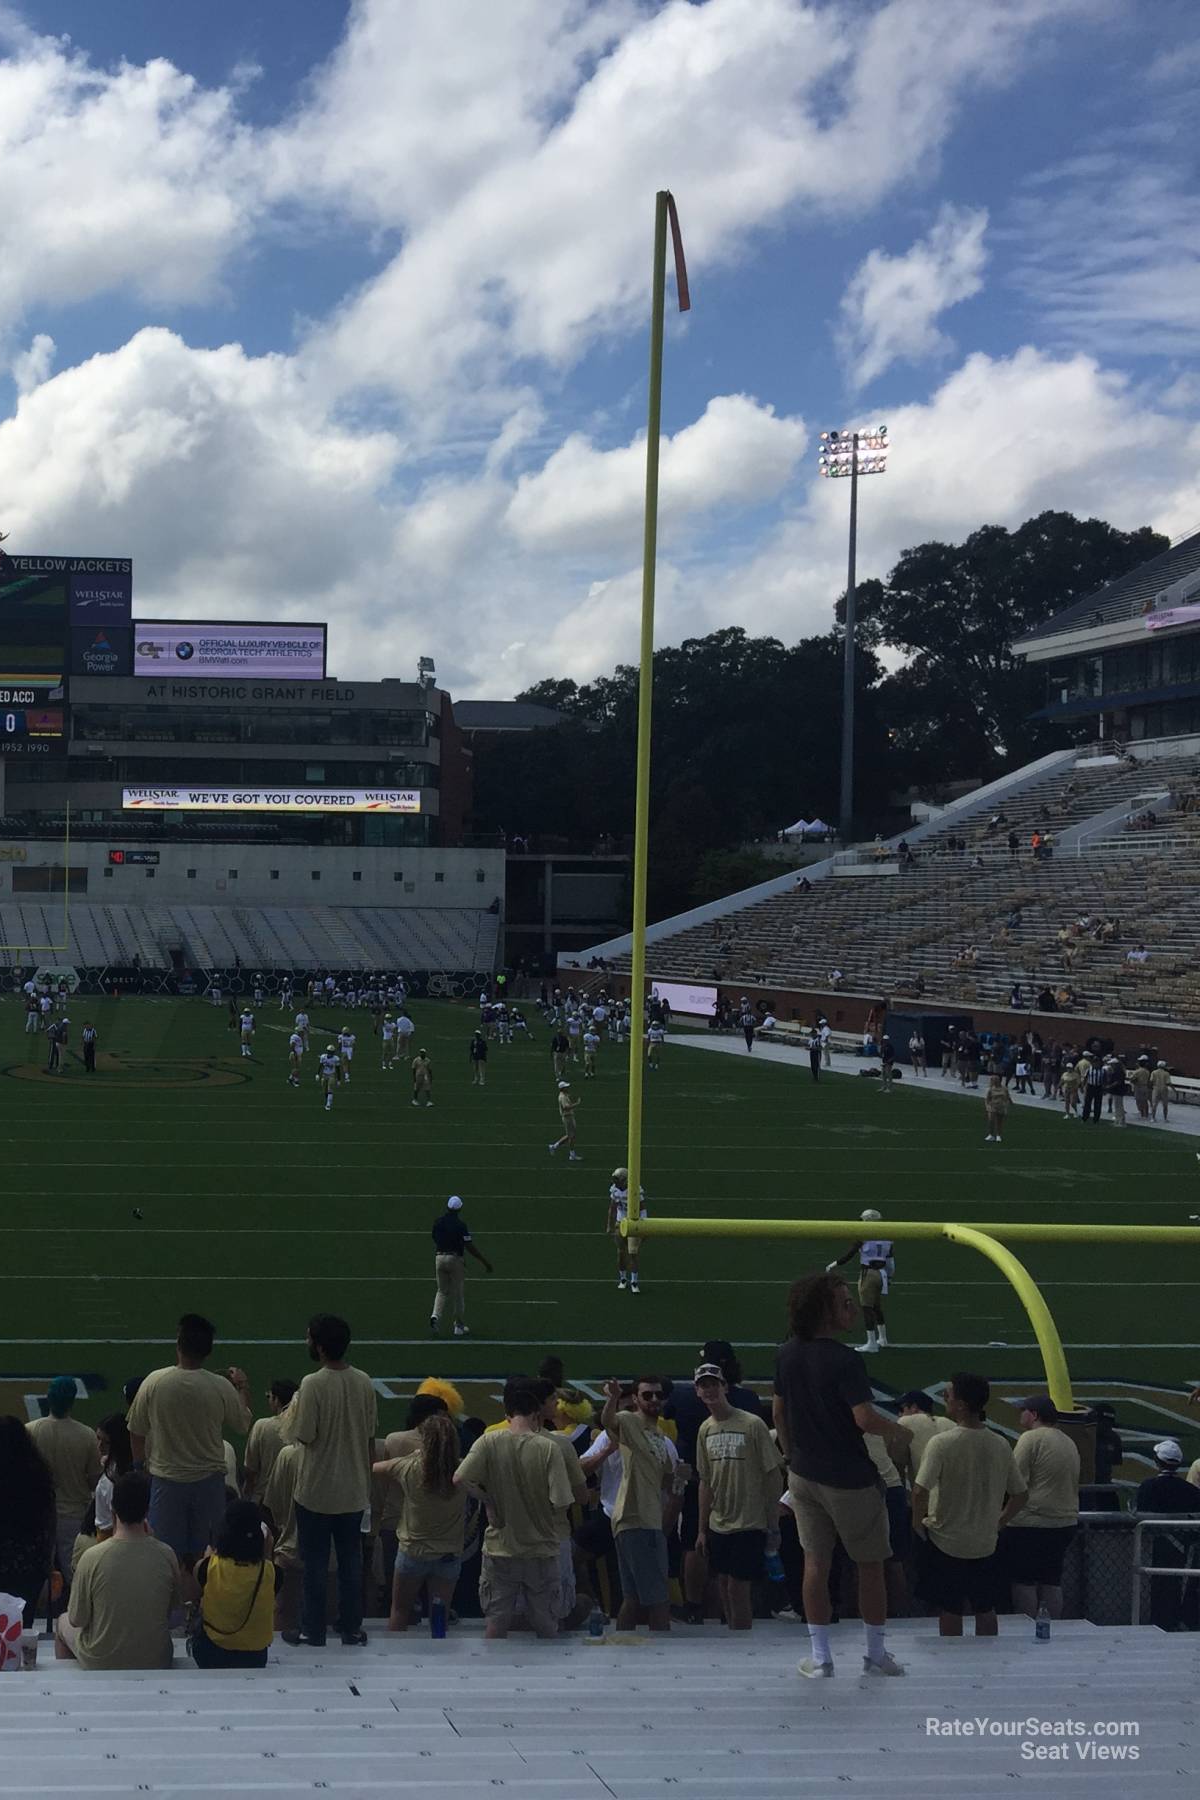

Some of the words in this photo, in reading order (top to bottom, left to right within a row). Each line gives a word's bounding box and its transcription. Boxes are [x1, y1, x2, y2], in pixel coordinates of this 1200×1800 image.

[11, 558, 67, 571] YELLOW
[70, 560, 130, 572] JACKETS
[199, 640, 236, 648] OFFICIAL
[238, 640, 272, 648] LUXURY
[309, 641, 321, 649] OF
[137, 642, 164, 659] GT
[265, 649, 312, 657] ATHLETICS
[83, 652, 118, 663] Georgia
[87, 662, 115, 671] Power
[12, 690, 34, 703] ACC)
[148, 685, 167, 697] AT
[172, 685, 246, 699] HISTORIC
[252, 687, 305, 700] GRANT
[312, 688, 354, 701] FIELD
[5, 713, 16, 733] 0
[2, 743, 24, 753] 1952
[27, 743, 50, 753] 1990
[128, 790, 177, 800] WELLSTAR
[189, 793, 230, 805] WE'VE
[233, 793, 261, 806] GOT
[264, 794, 291, 806] YOU
[295, 794, 355, 807] COVERED
[365, 793, 414, 802] WELLSTAR
